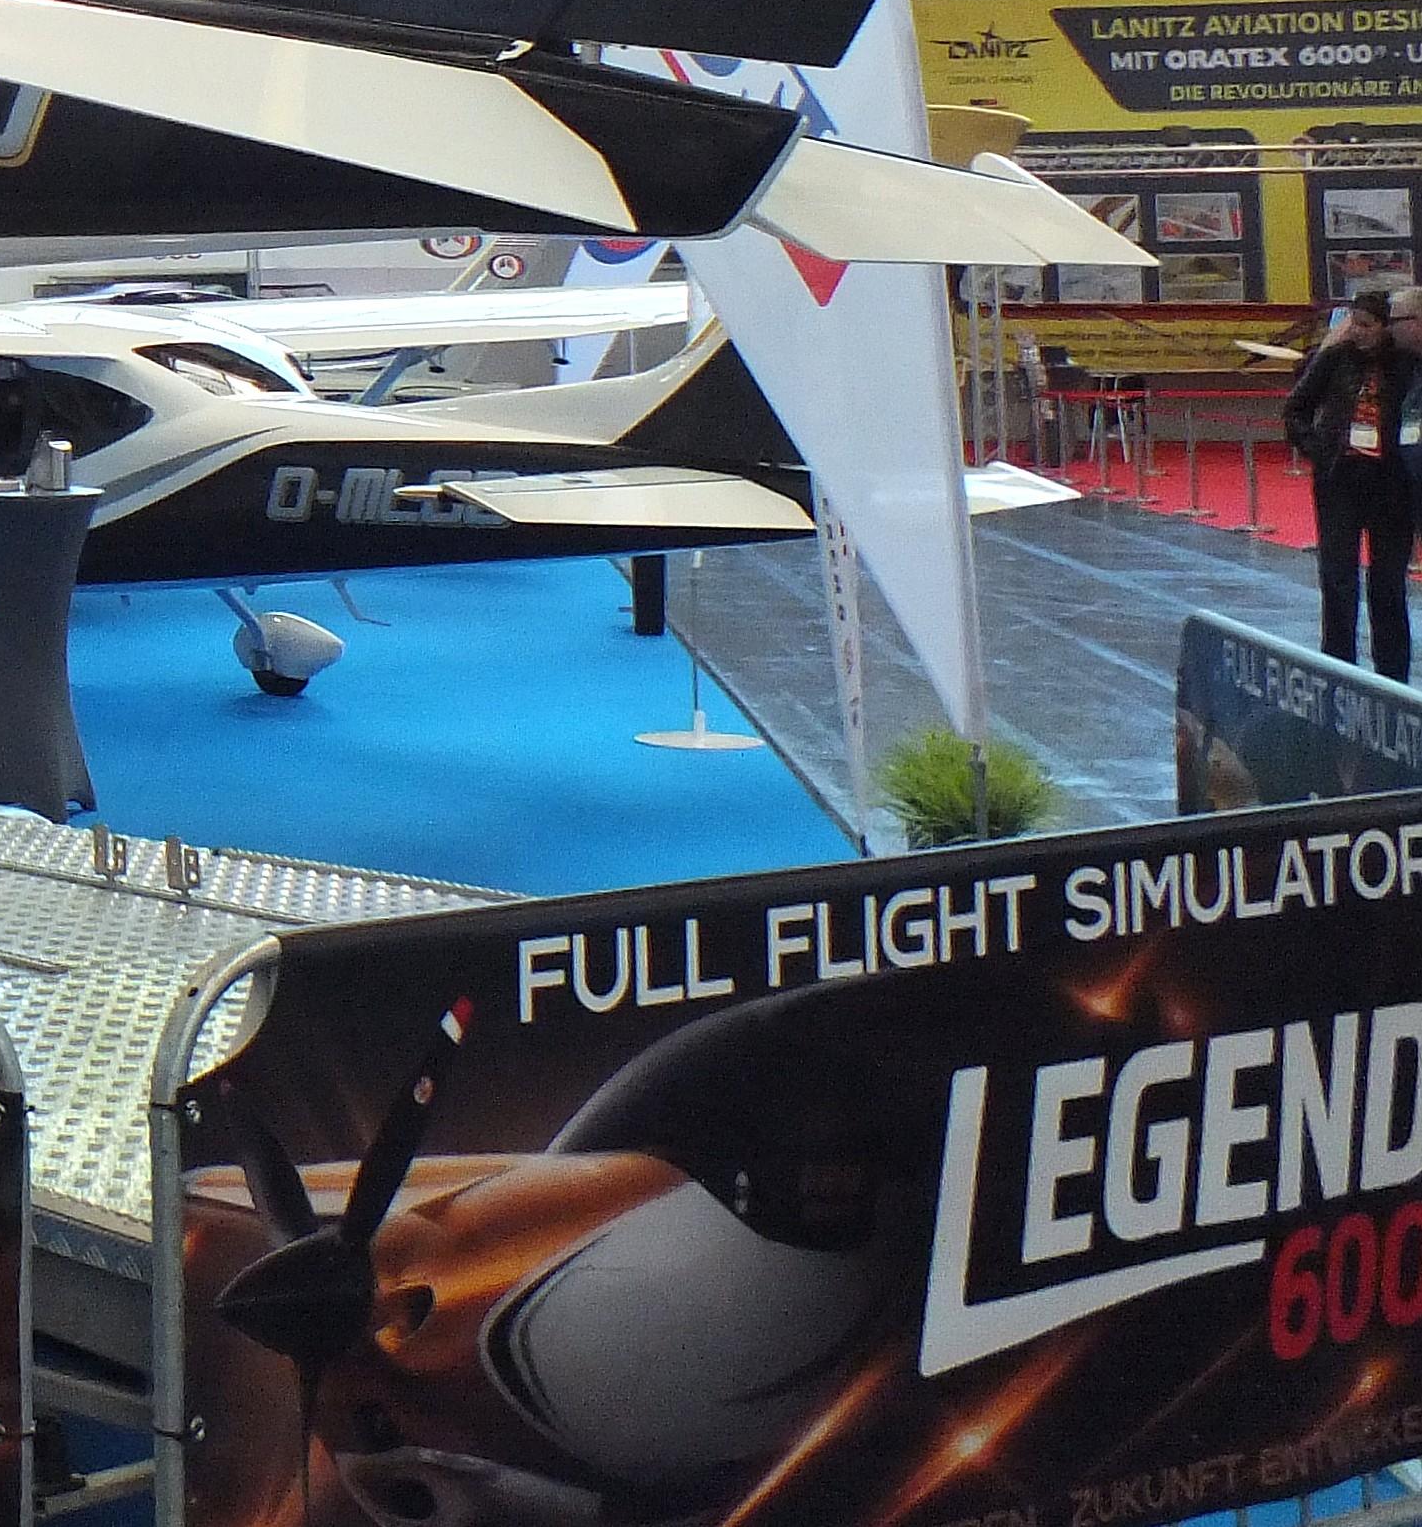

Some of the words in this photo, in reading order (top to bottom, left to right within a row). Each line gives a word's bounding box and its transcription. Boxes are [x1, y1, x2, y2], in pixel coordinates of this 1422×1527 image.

[1091, 17, 1195, 40] LANITZ
[1204, 10, 1345, 37] AVIATION
[1352, 8, 1422, 33] DESI
[1110, 50, 1158, 72] MIT
[1163, 45, 1290, 71] ORATEX
[1169, 83, 1206, 102] DIE
[1210, 75, 1392, 102] REVOLUTIONÄRE
[518, 918, 735, 1025] FULL
[767, 874, 1036, 989] FLIGHT
[918, 1001, 1422, 1379] LEGEND
[1269, 1200, 1422, 1360] 600
